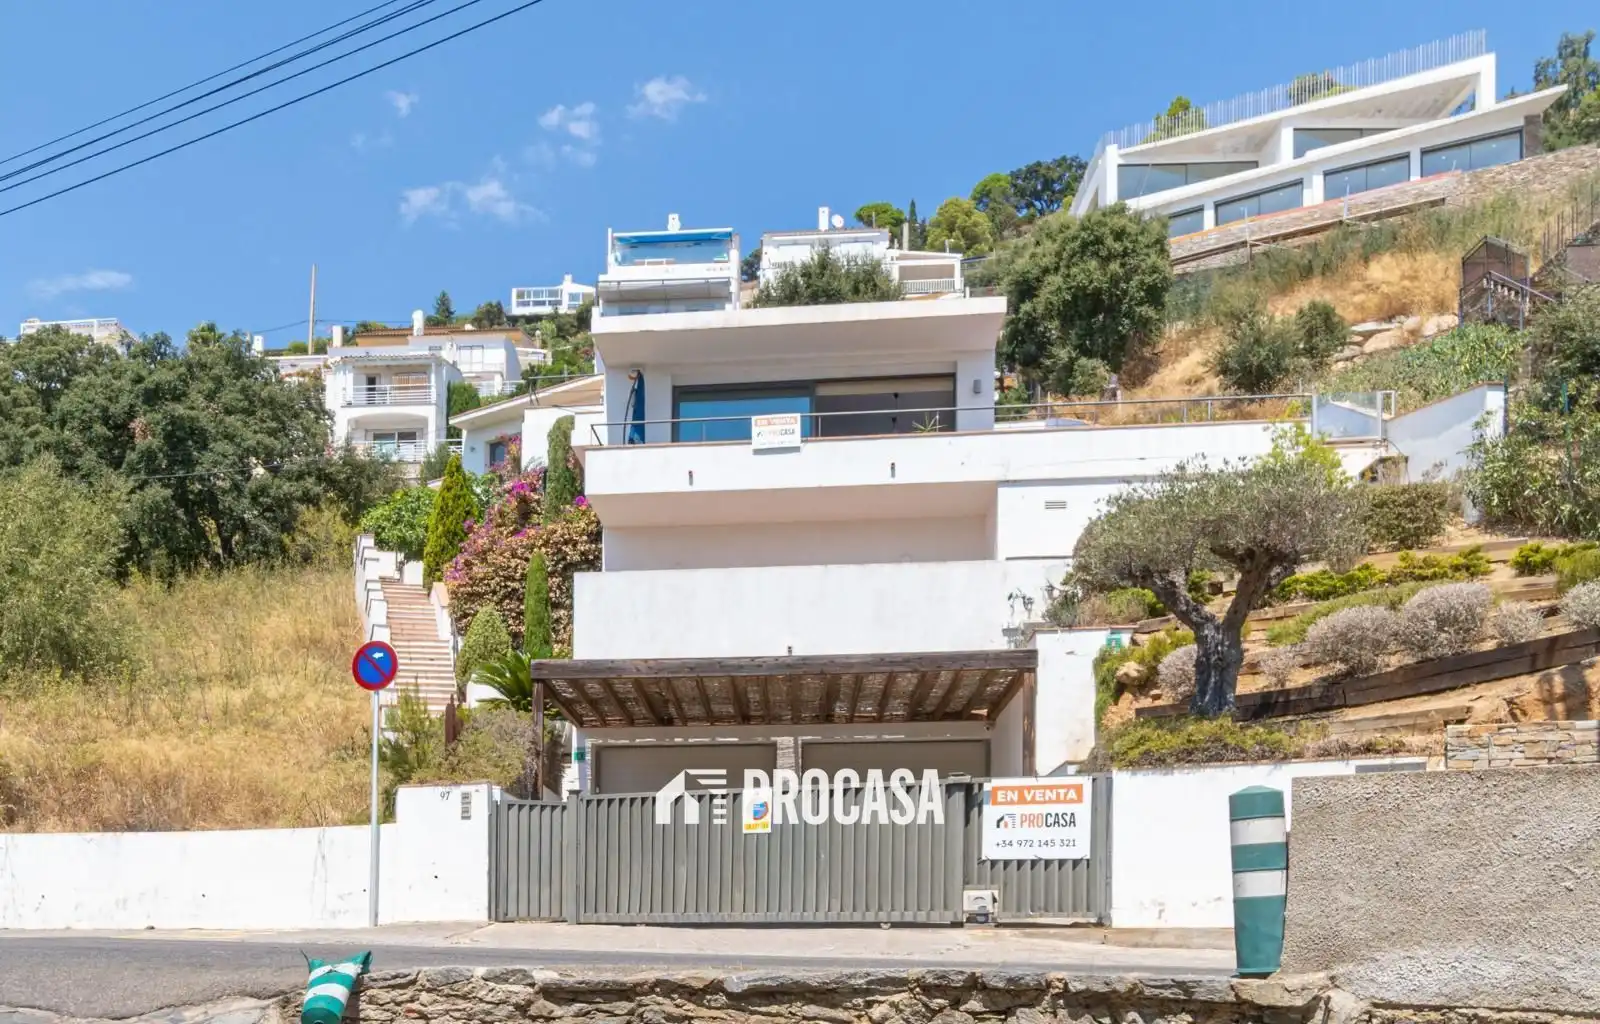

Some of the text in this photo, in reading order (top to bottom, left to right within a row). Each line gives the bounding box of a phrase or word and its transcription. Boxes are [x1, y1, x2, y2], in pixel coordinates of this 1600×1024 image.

[440, 790, 450, 801] 97
[997, 788, 1077, 802] EN VENTA
[1020, 812, 1076, 828] PROCASA
[996, 838, 1077, 848] +34 972 145 321
